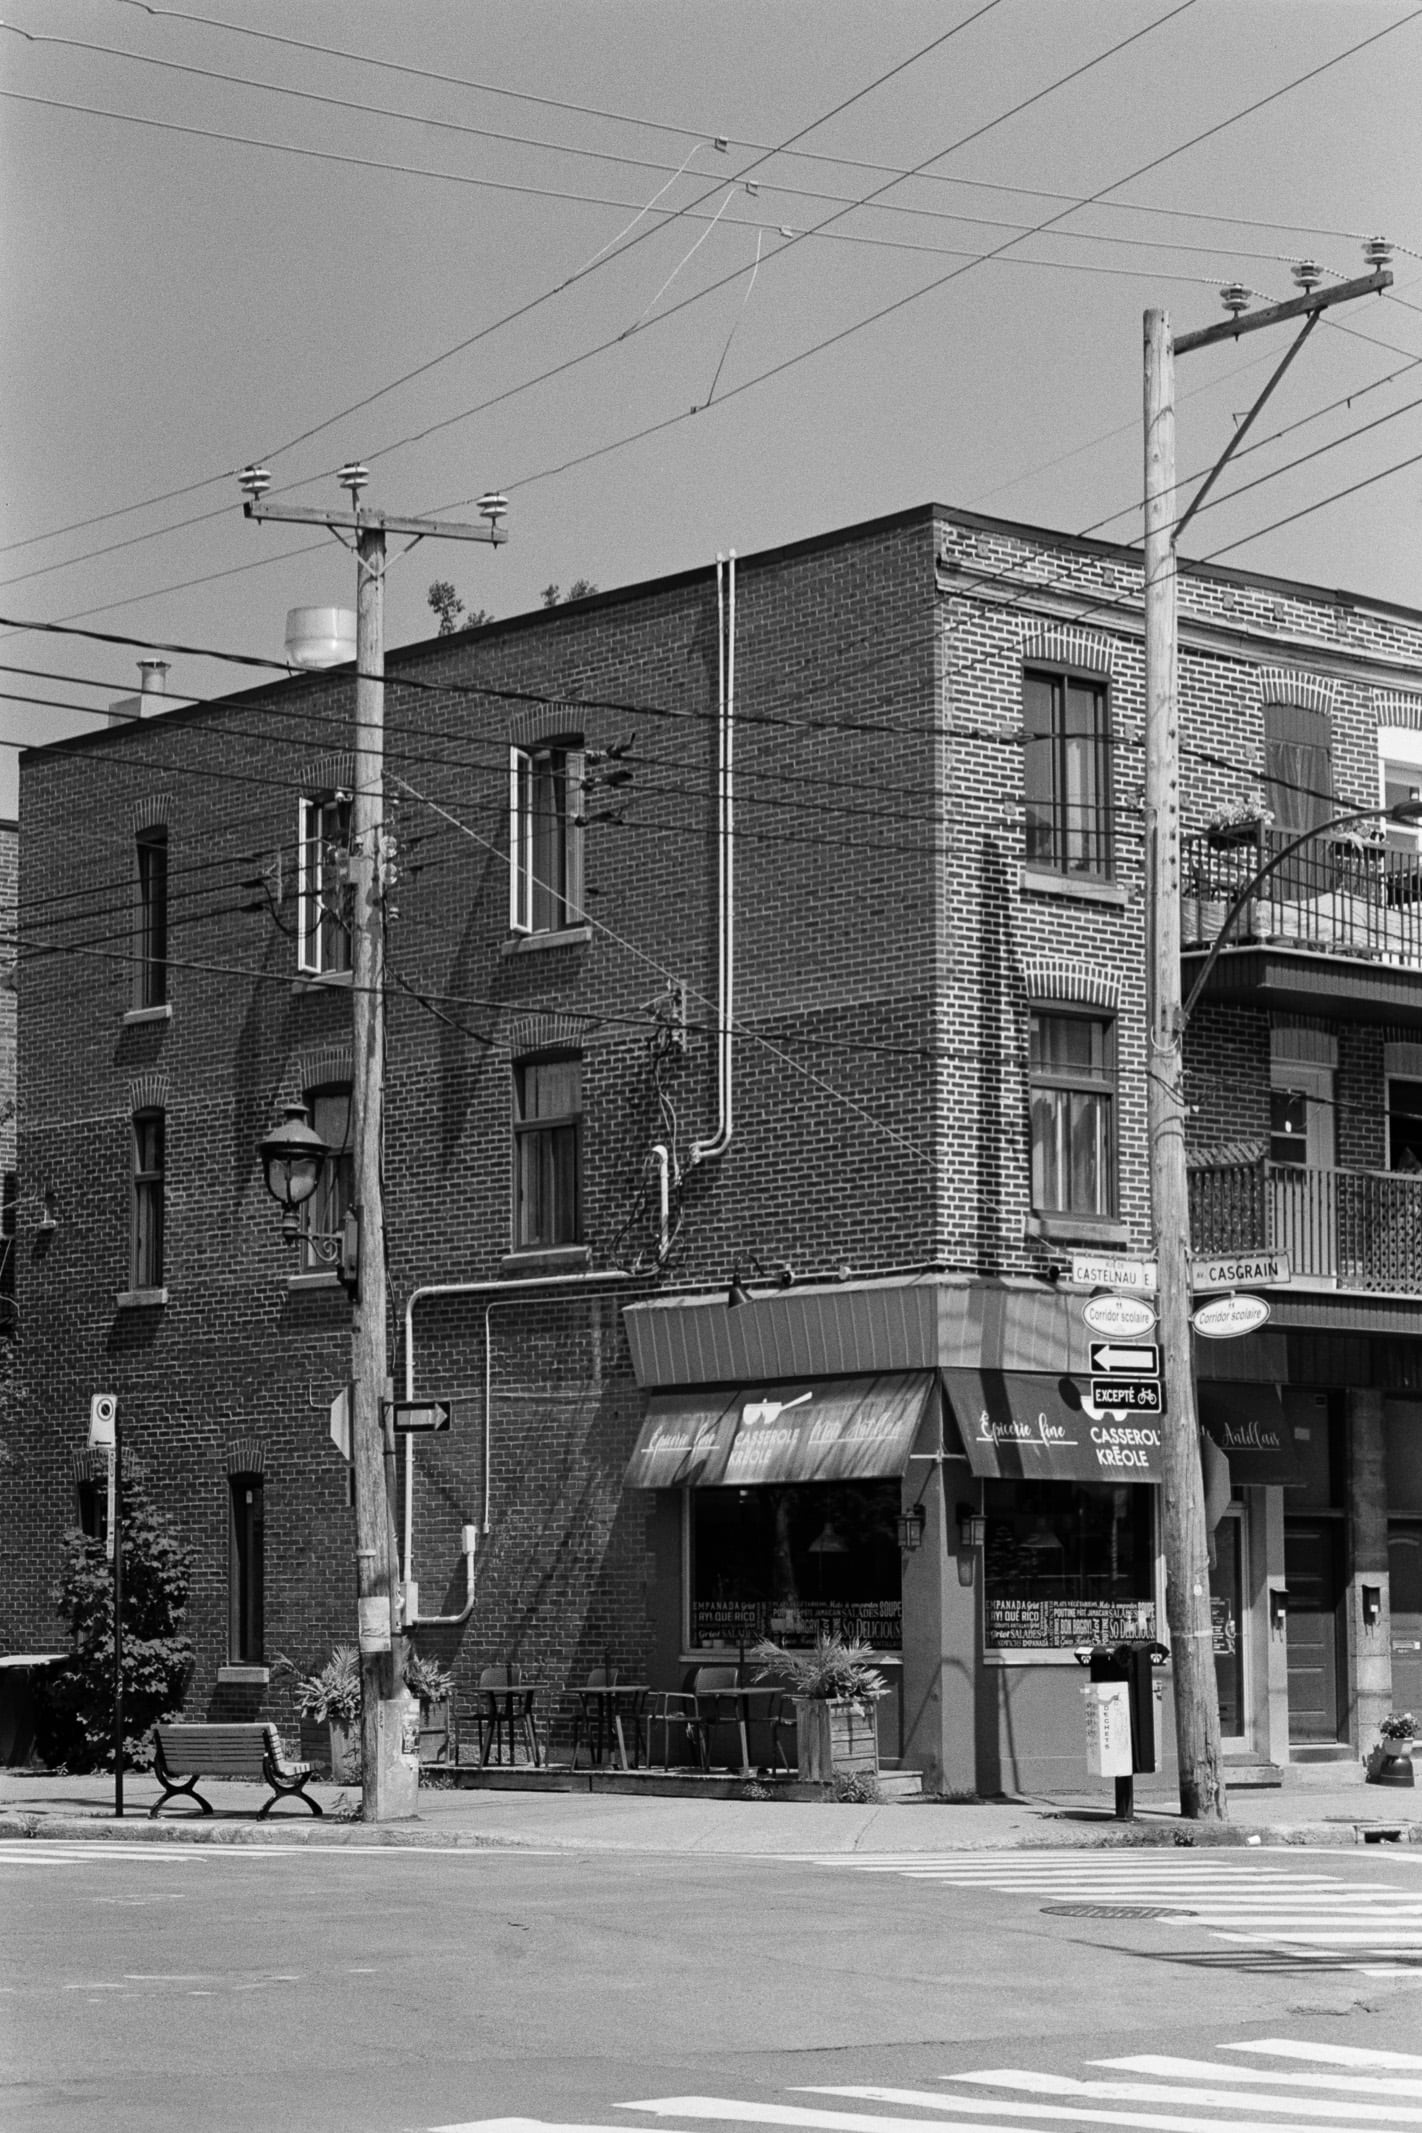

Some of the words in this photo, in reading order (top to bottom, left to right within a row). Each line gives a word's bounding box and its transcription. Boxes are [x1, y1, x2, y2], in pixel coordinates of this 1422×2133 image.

[1076, 1267, 1137, 1285] CASTELNAU
[1209, 1262, 1278, 1281] CASGRAIN
[1090, 1307, 1119, 1322] Corridor
[1121, 1312, 1150, 1324] scolaire
[1199, 1311, 1230, 1324] Corridor
[1231, 1307, 1262, 1320] scolaire
[1095, 1386, 1136, 1403] EXCEPTÉ
[735, 1428, 801, 1446] CASSEROLE
[980, 1410, 1032, 1448] Épicerie
[1038, 1412, 1066, 1447] fine
[1090, 1427, 1161, 1446] CASSEROL
[1223, 1421, 1280, 1448] Antillais
[735, 1611, 756, 1622] RICO
[841, 1608, 879, 1618] SALADES
[1004, 1609, 1020, 1622] QUÉ
[1021, 1611, 1040, 1622] RICO
[1053, 1608, 1076, 1618] POUTINE
[843, 1618, 855, 1639] SO
[1010, 1629, 1042, 1639] SALADES
[1109, 1618, 1119, 1639] SO
